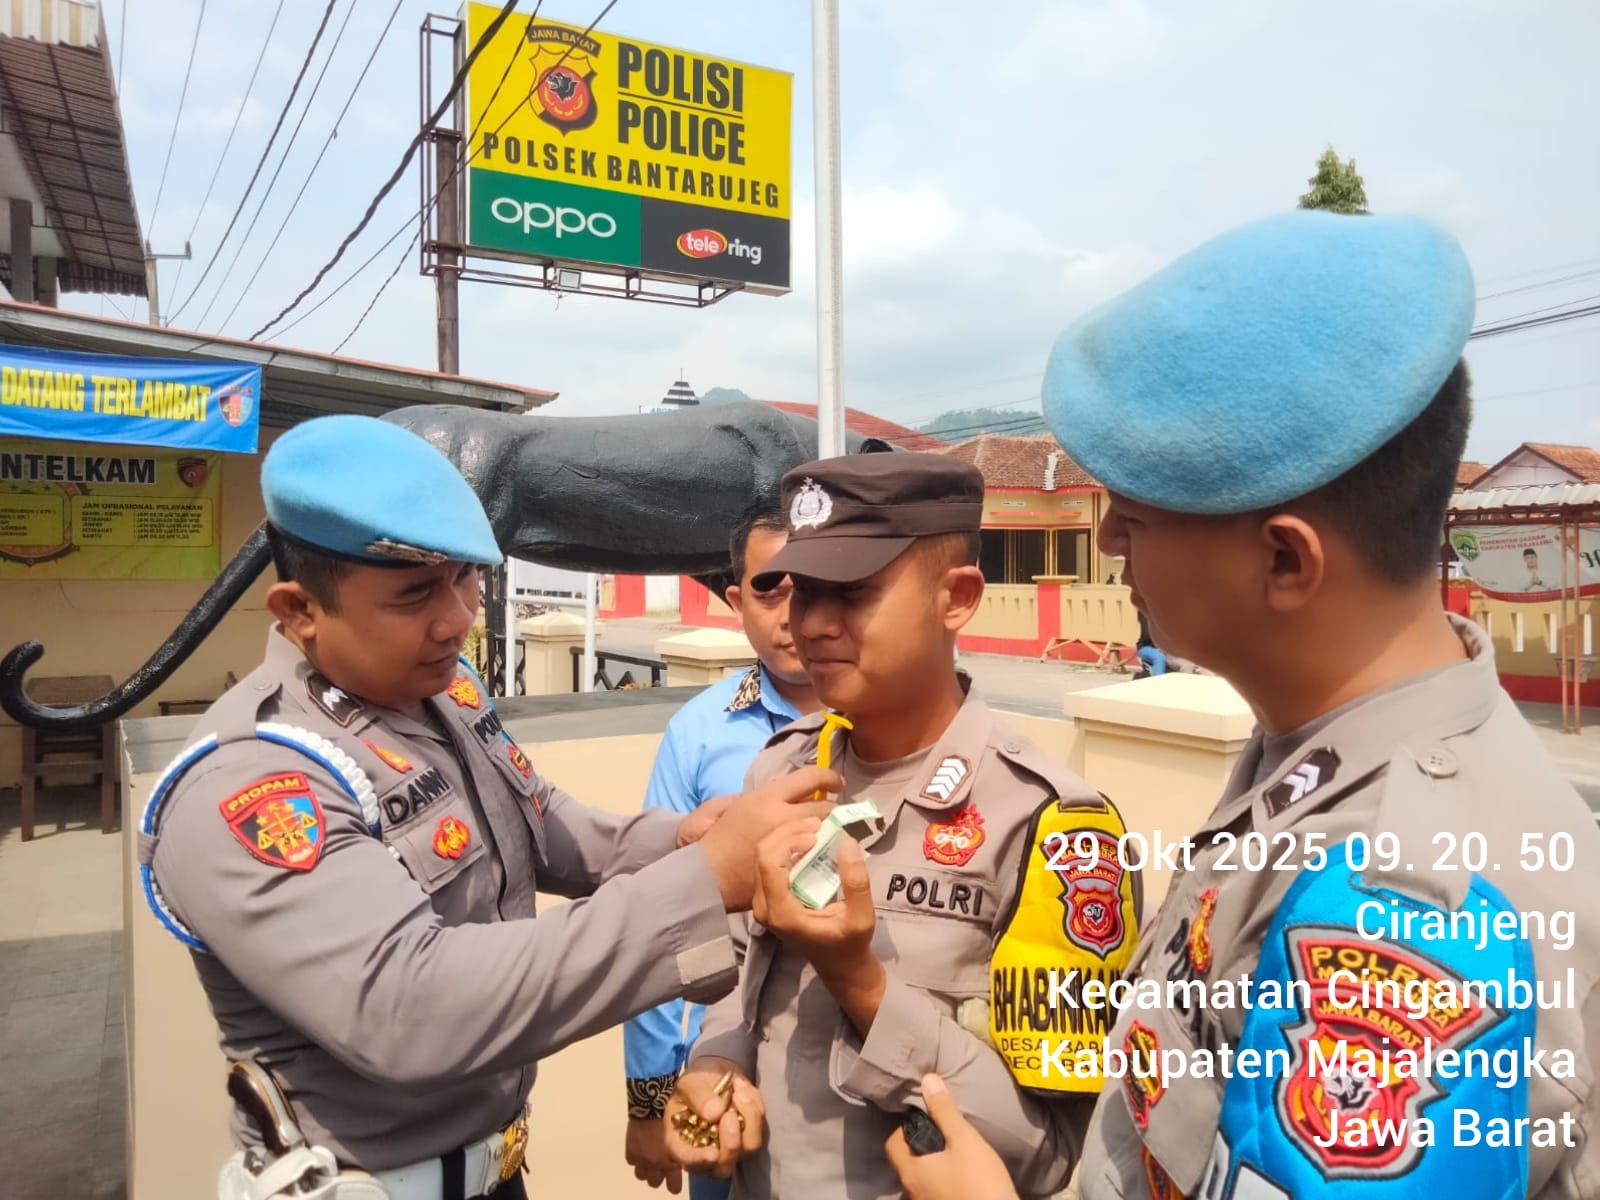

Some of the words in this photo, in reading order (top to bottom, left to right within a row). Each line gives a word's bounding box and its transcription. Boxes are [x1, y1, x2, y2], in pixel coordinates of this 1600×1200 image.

[531, 29, 560, 40] JAWA
[617, 41, 744, 113] POLISI
[617, 99, 746, 166] POLICE
[483, 132, 597, 179] POLSEK
[606, 154, 779, 209] BANTARUJEG
[491, 197, 617, 239] oppo
[686, 231, 721, 254] tele
[728, 240, 762, 265] ring
[1, 366, 85, 412] DATANG
[91, 375, 211, 422] TERLAMBAT
[1, 453, 155, 483] NTELKAM
[227, 778, 300, 812] PROPAM
[887, 873, 984, 916] POLRI
[1367, 1009, 1422, 1048] BARAT
